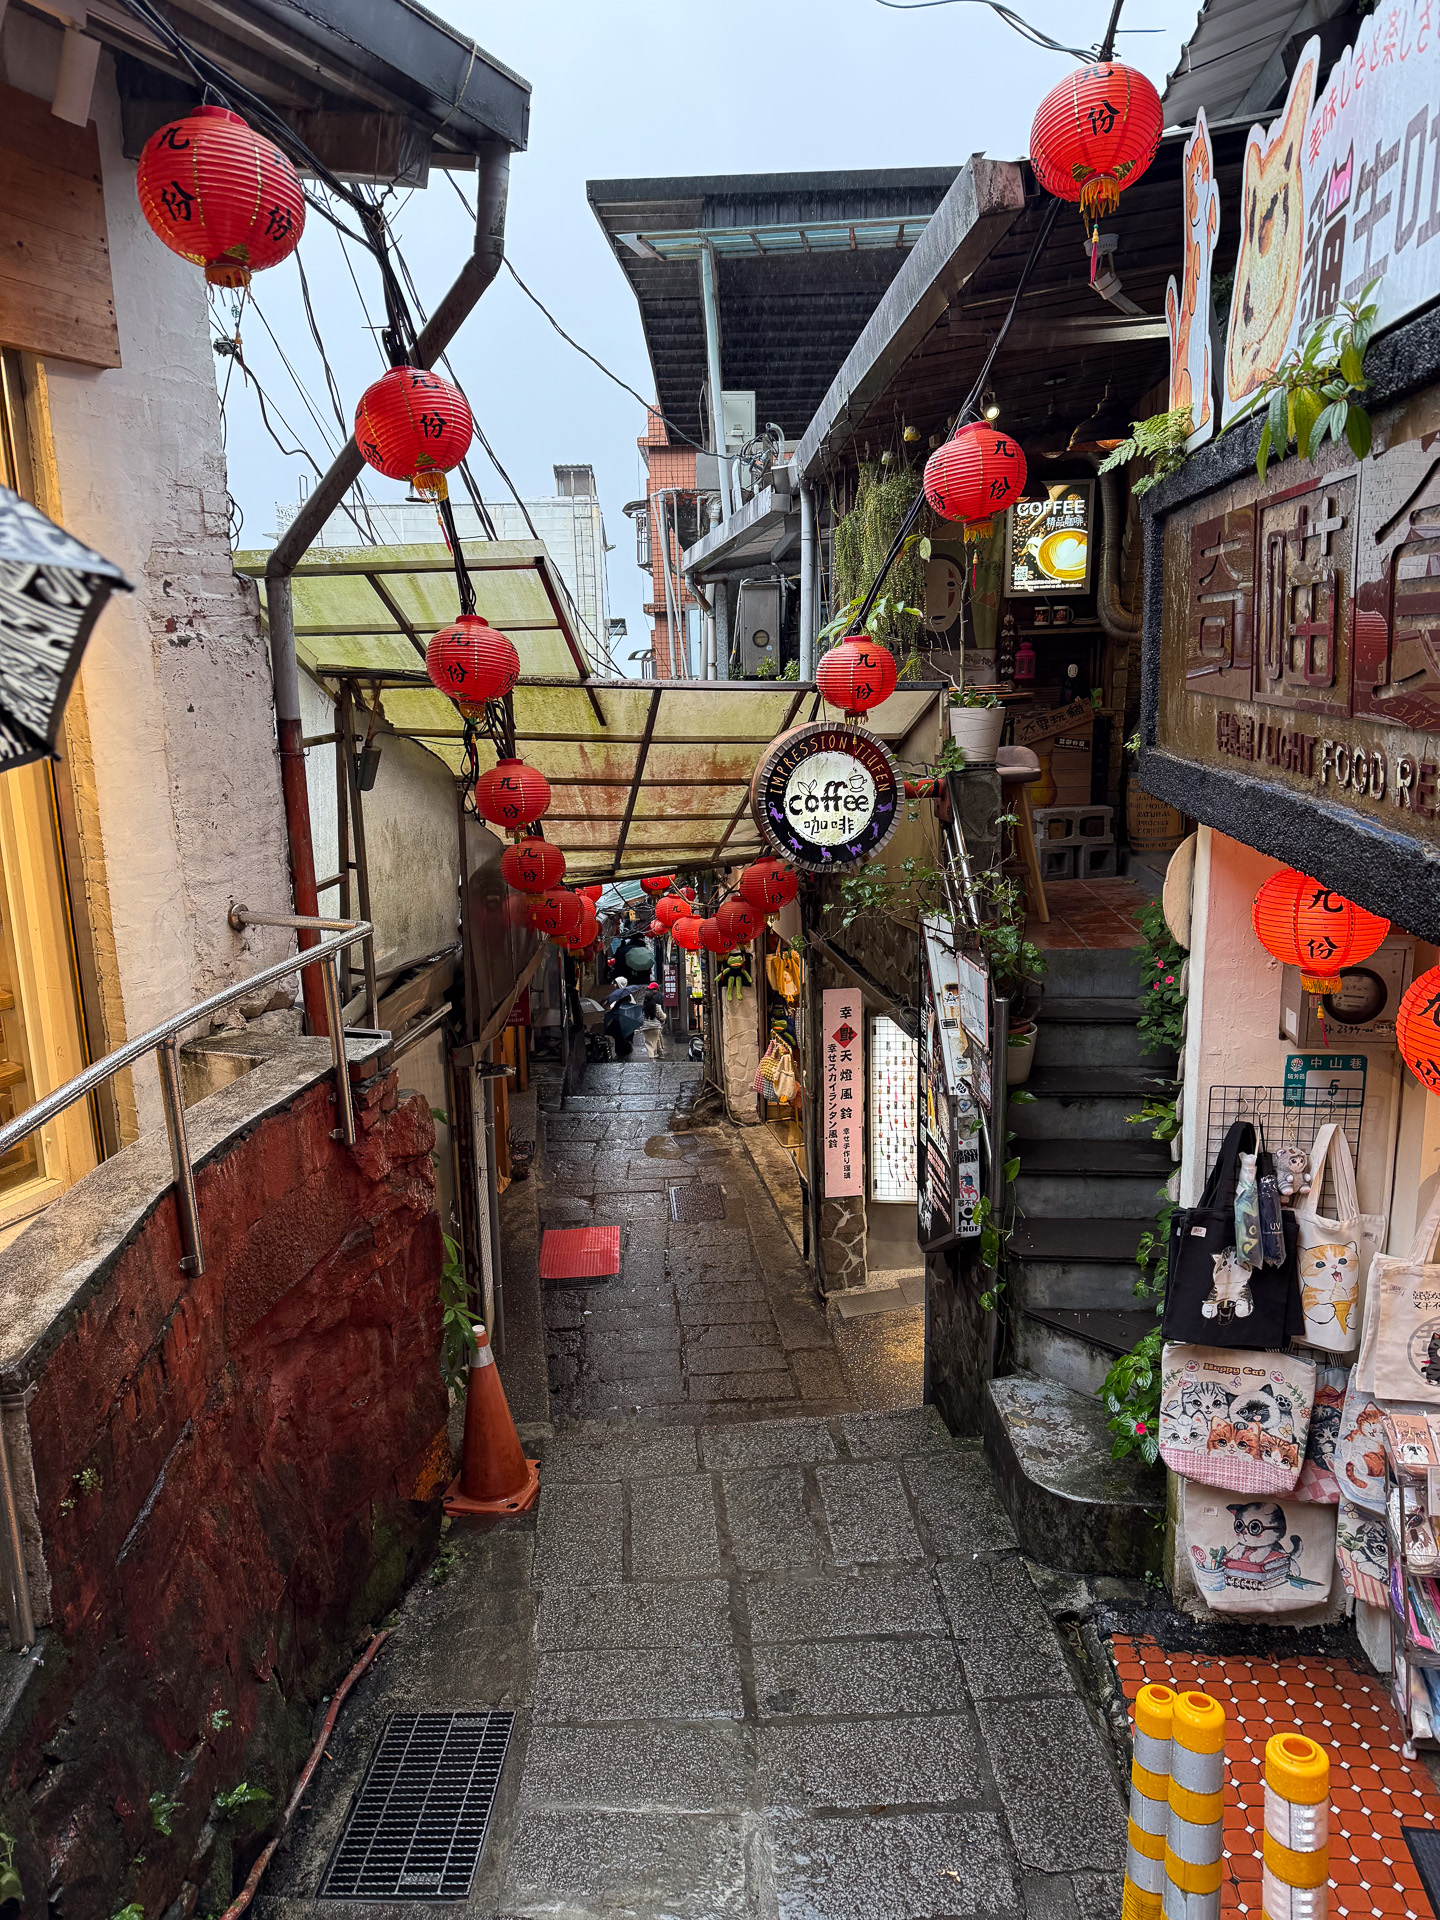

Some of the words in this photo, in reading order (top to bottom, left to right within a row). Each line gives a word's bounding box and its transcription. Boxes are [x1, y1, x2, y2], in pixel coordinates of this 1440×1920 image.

[1079, 66, 1120, 137] 九份
[157, 126, 197, 222] 九份
[411, 374, 447, 439] 九份
[990, 440, 1015, 500] 九份
[1017, 499, 1086, 517] COFFEE
[1046, 515, 1085, 528] 精品咖啡
[446, 631, 471, 684] 九份
[854, 653, 877, 700] 九份
[769, 734, 848, 795] IMPRESSION
[854, 742, 891, 793] JIUFEN
[1265, 725, 1318, 778] LIGHT
[1321, 738, 1388, 801] FOOD
[1395, 756, 1440, 818] RE
[500, 777, 520, 820] 九份
[803, 815, 856, 836] 咖啡
[521, 847, 538, 883] 九份
[769, 871, 785, 904] 九份
[543, 898, 559, 930] 九份
[736, 914, 751, 941] 九份
[1306, 889, 1344, 961] 九份
[1310, 1056, 1363, 1070] 中山巷
[827, 1043, 838, 1150] 幸せスカイランタン風鈴
[1327, 1078, 1341, 1097] 5
[1269, 1222, 1281, 1232] UV
[1203, 1362, 1241, 1376] Happy
[1243, 1366, 1266, 1377] Cat
